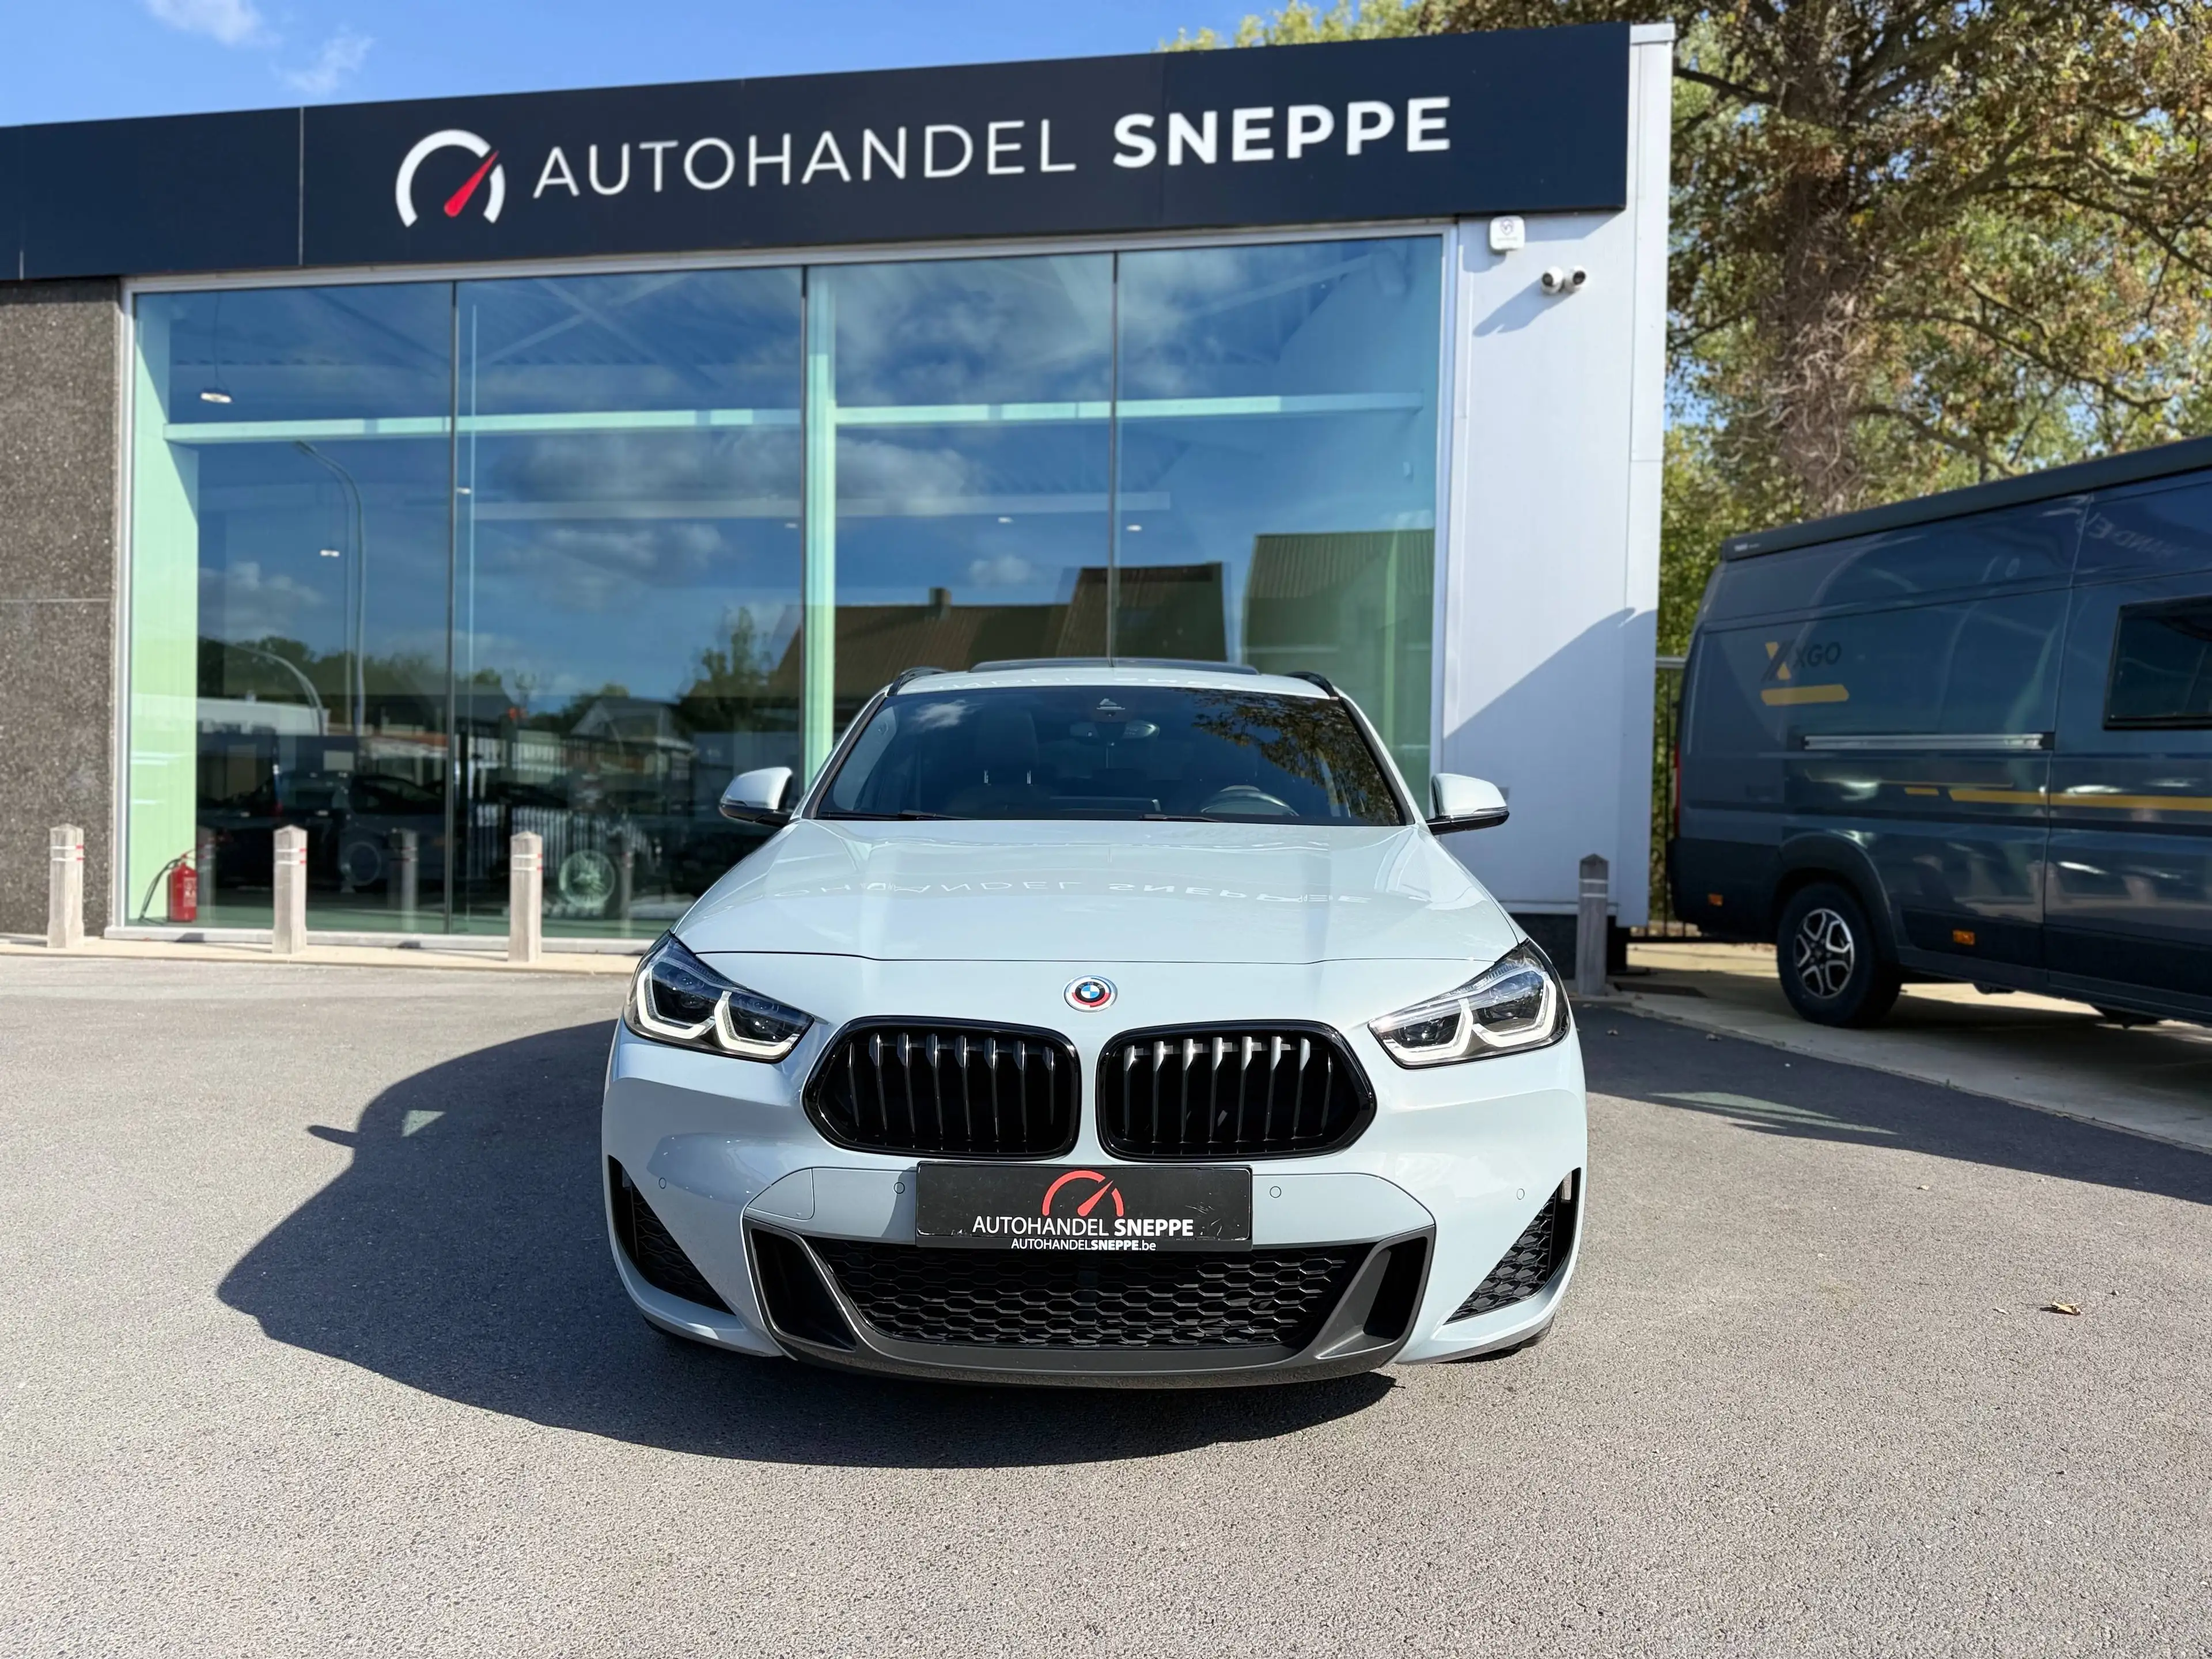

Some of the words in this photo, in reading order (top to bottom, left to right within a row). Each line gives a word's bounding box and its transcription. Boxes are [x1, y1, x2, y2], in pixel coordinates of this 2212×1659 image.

[533, 118, 1076, 199] AUTOHANDEL
[1112, 96, 1450, 169] SNEPPE
[972, 1215, 1109, 1236] AUTOHANDEL
[1113, 1218, 1194, 1237] SNEPPE
[1011, 1238, 1157, 1251] AUTOHANDELSNEPPE.be
